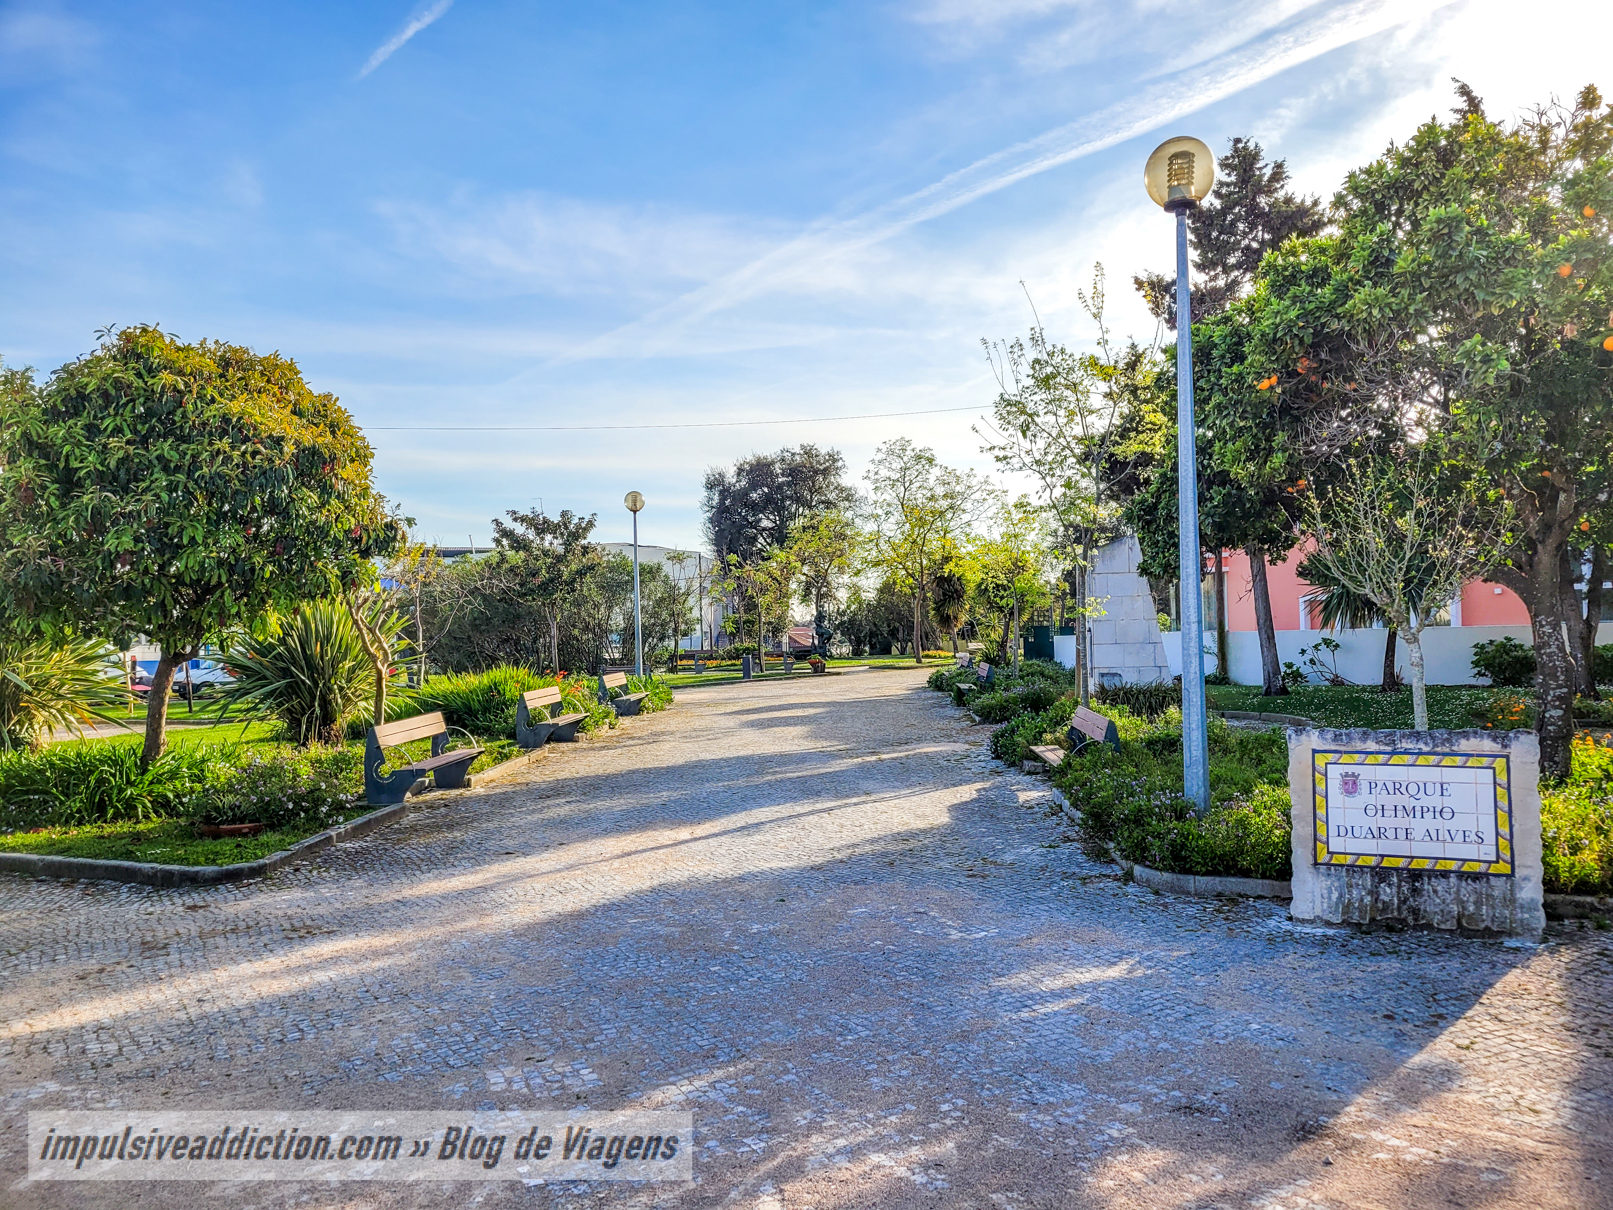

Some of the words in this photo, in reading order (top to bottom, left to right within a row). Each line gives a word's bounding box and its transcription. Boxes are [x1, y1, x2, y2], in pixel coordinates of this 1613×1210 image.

[1367, 781, 1452, 800] PARQUE
[1364, 803, 1455, 820] OLIMPIO
[1336, 824, 1416, 841] DUARTE
[1421, 828, 1485, 845] ALVES
